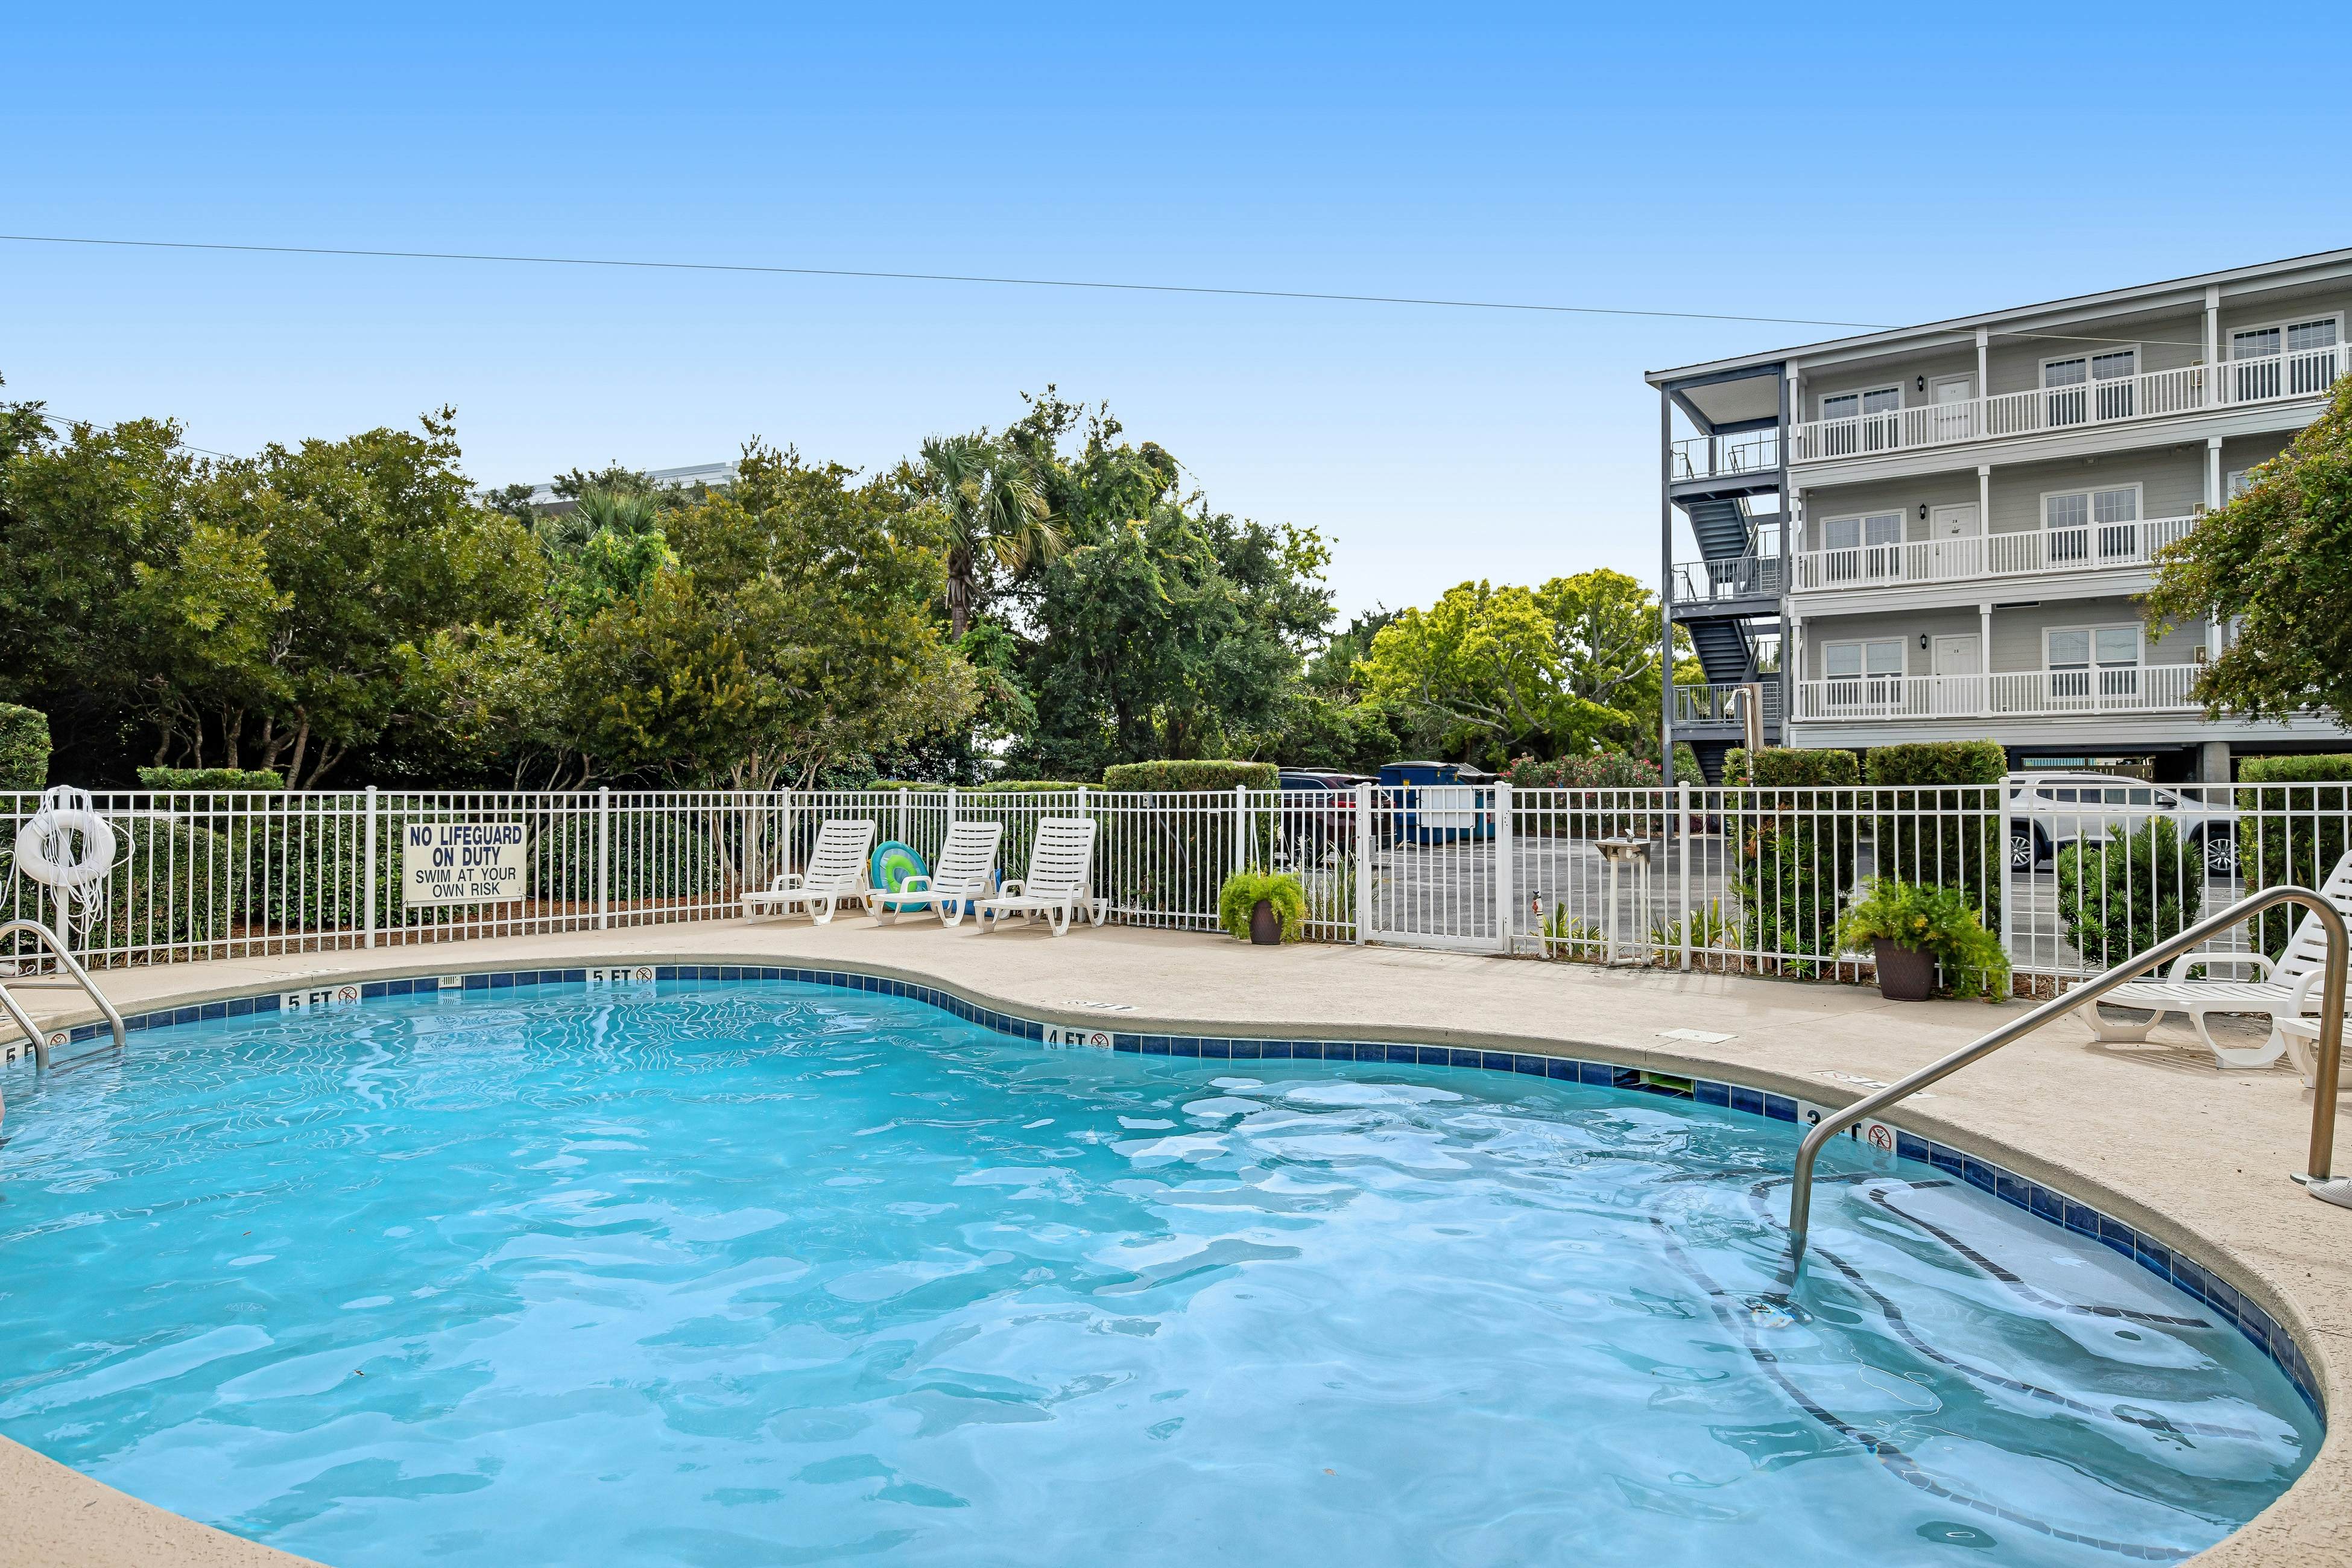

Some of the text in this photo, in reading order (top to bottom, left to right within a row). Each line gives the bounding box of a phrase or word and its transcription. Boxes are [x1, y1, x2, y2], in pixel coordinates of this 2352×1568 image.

[410, 826, 522, 846] NO LIFEGUARD
[433, 846, 501, 867] ON DUTY
[416, 867, 516, 884] SWIM AT YOUR
[432, 883, 464, 897] OWN
[471, 882, 501, 896] RISK
[593, 969, 631, 981] 5 FT
[288, 990, 332, 1007] 5 FT
[1048, 1029, 1086, 1046] 4 FT
[6, 1047, 16, 1063] 5
